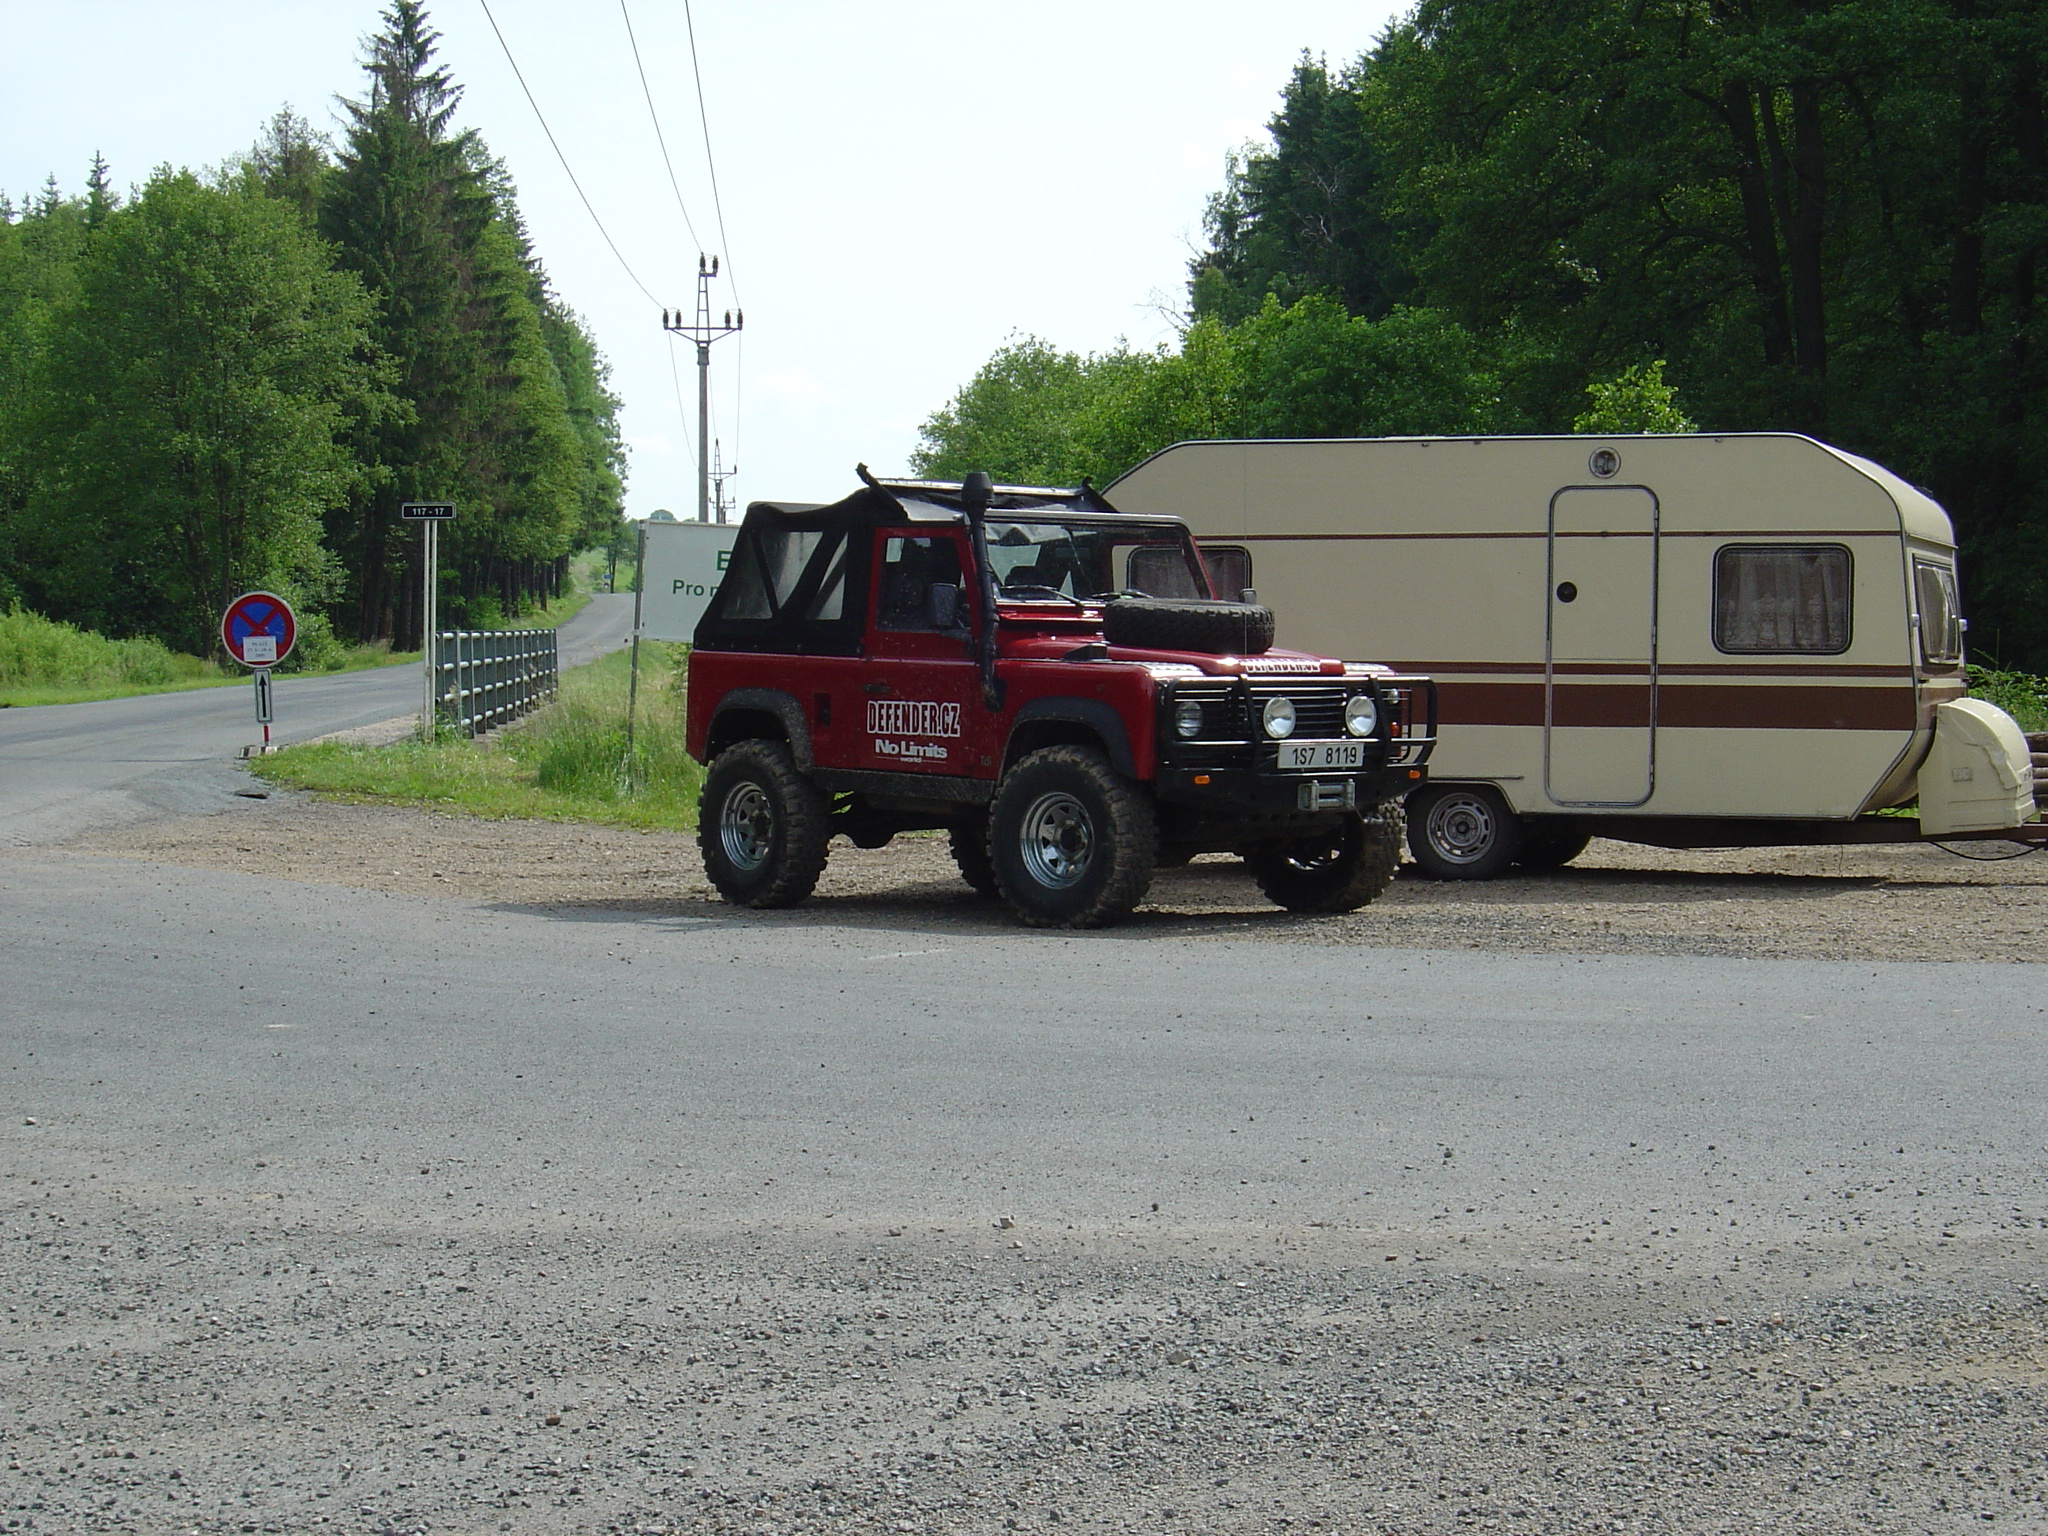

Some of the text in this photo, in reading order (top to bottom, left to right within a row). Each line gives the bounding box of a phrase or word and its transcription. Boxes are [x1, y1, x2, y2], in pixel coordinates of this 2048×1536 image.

[412, 508, 427, 516] 117
[434, 508, 445, 516] 17
[673, 579, 705, 597] Pro
[867, 700, 960, 738] DEFENDER.CZ
[875, 739, 948, 759] No Limits
[1293, 746, 1357, 766] 1S7 8119
[900, 756, 922, 764] world
